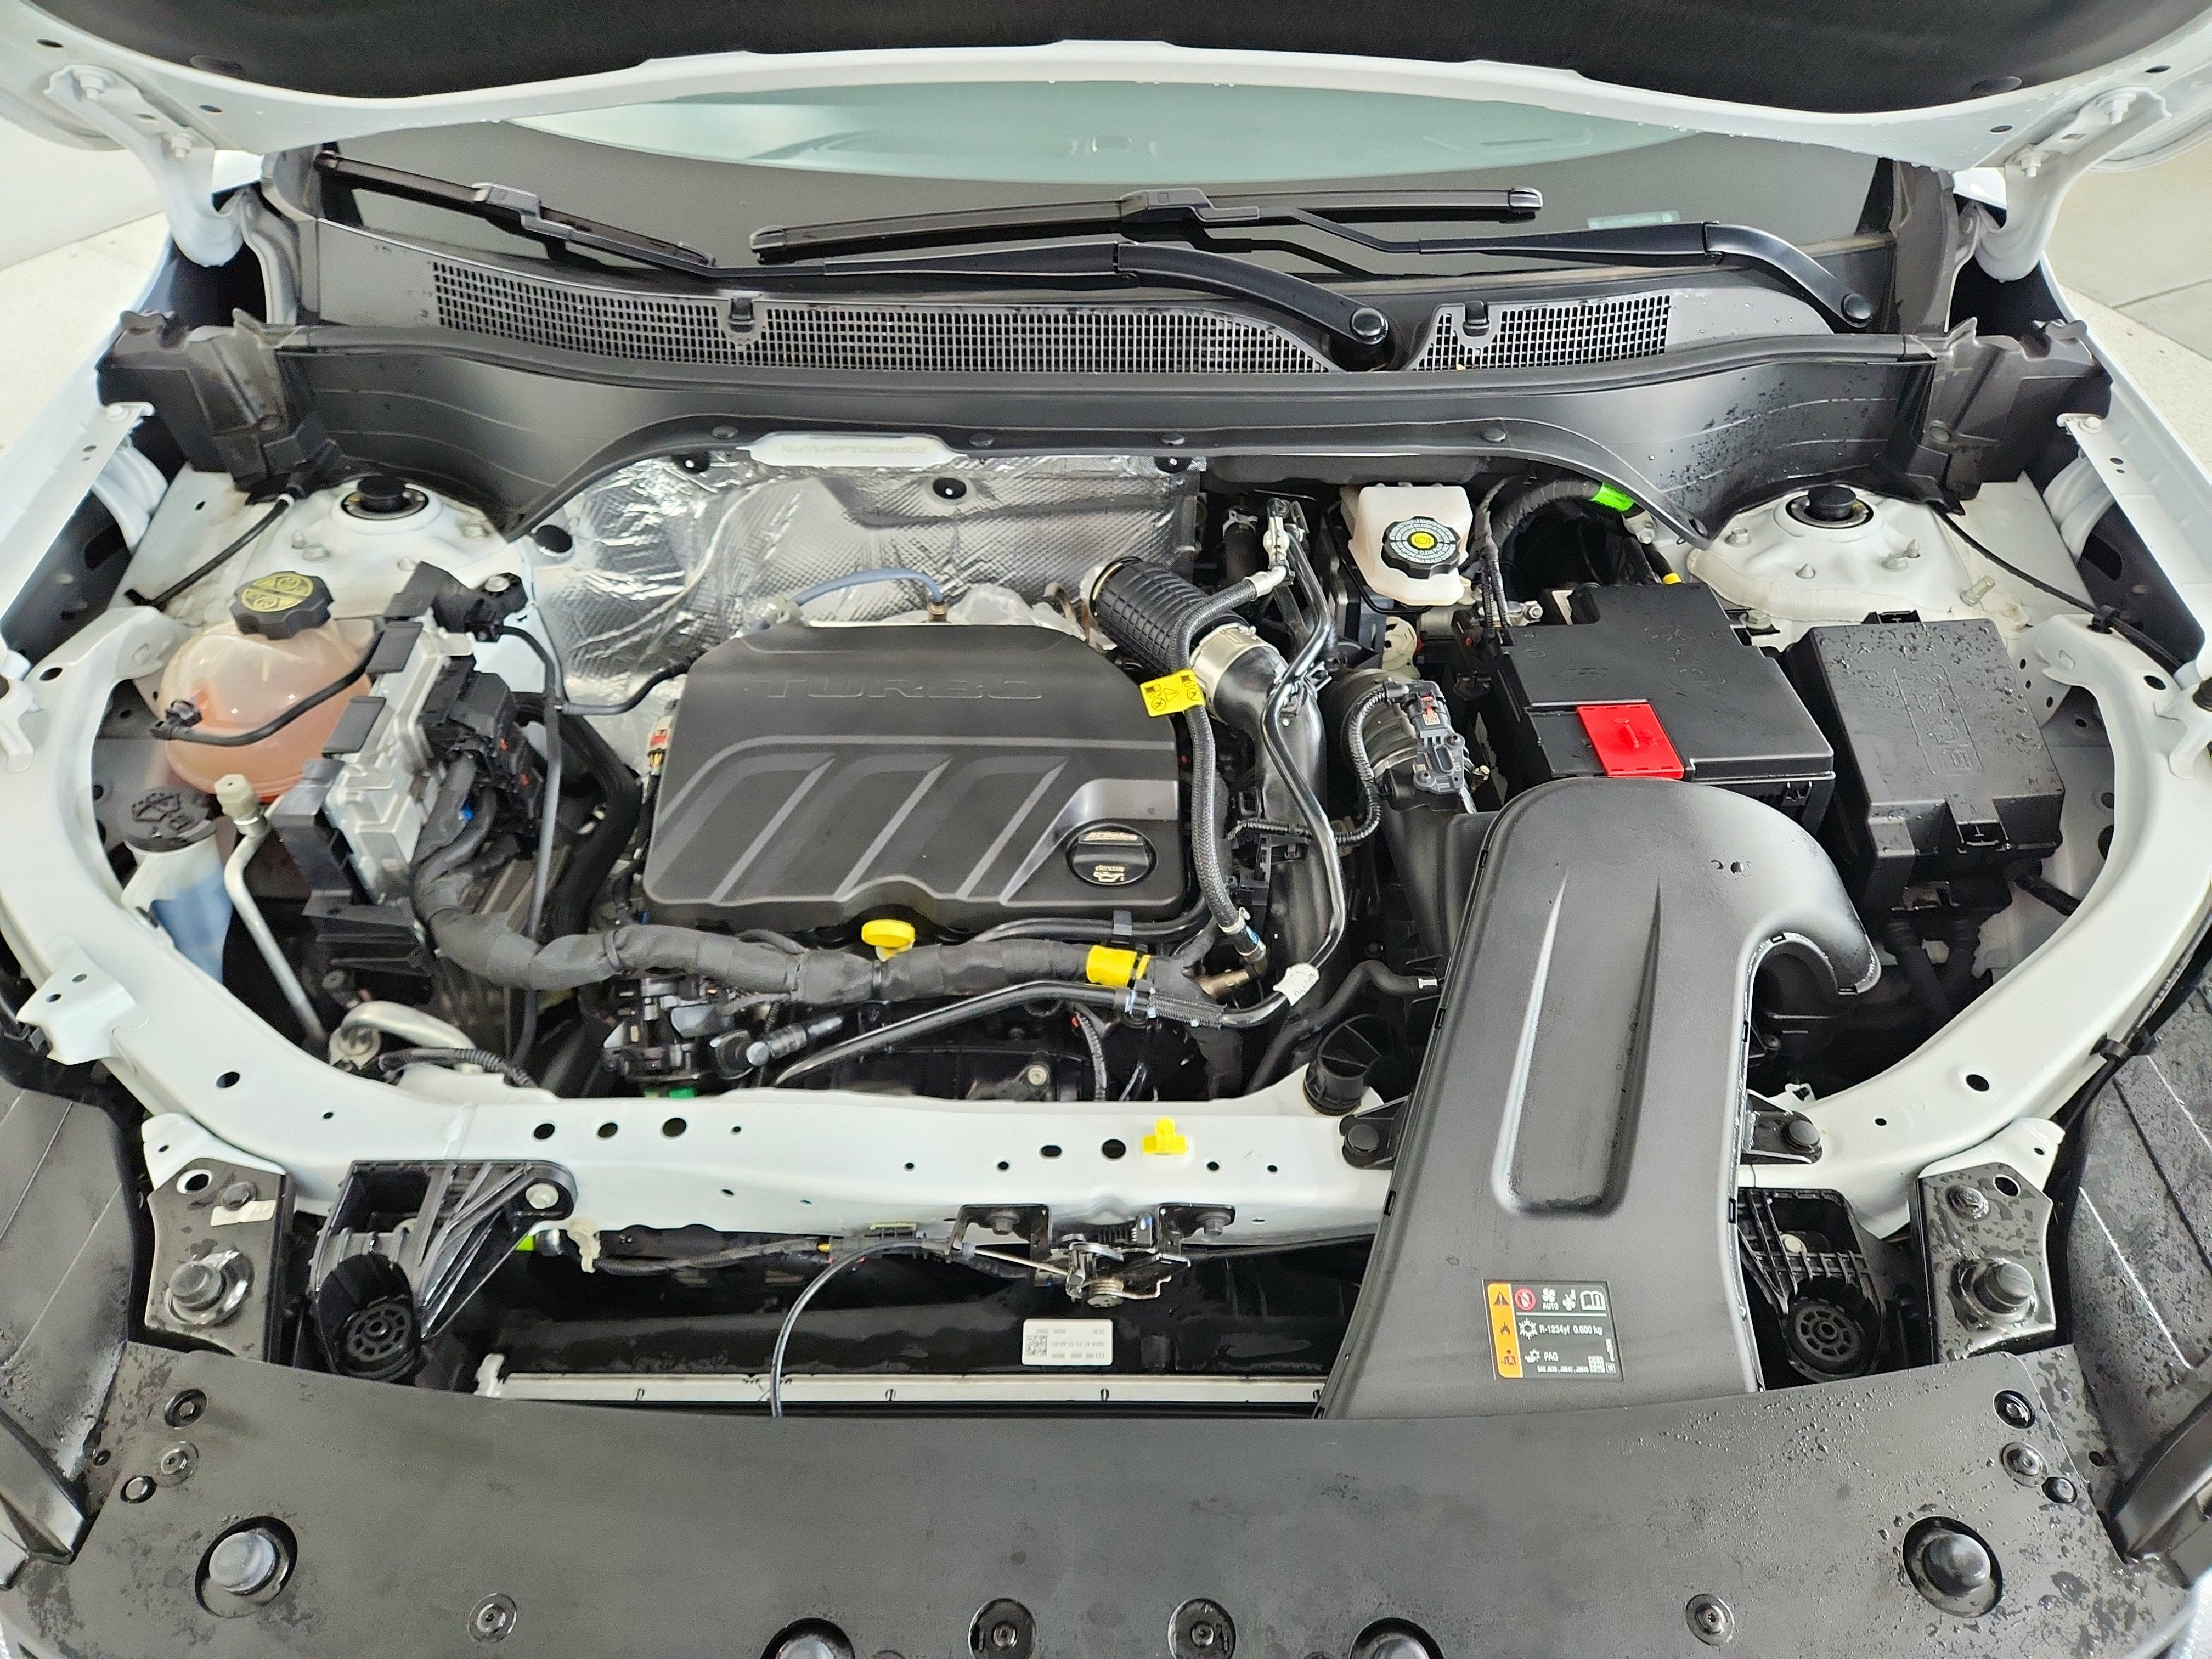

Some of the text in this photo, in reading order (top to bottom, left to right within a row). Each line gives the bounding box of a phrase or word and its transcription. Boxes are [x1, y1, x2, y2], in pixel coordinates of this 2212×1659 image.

[753, 675, 1042, 699] TURBO
[1084, 831, 1138, 840] ACDelco
[1539, 1324, 1570, 1335] R-1234yf
[1593, 1325, 1603, 1336] kg
[1543, 1351, 1559, 1362] PAG
